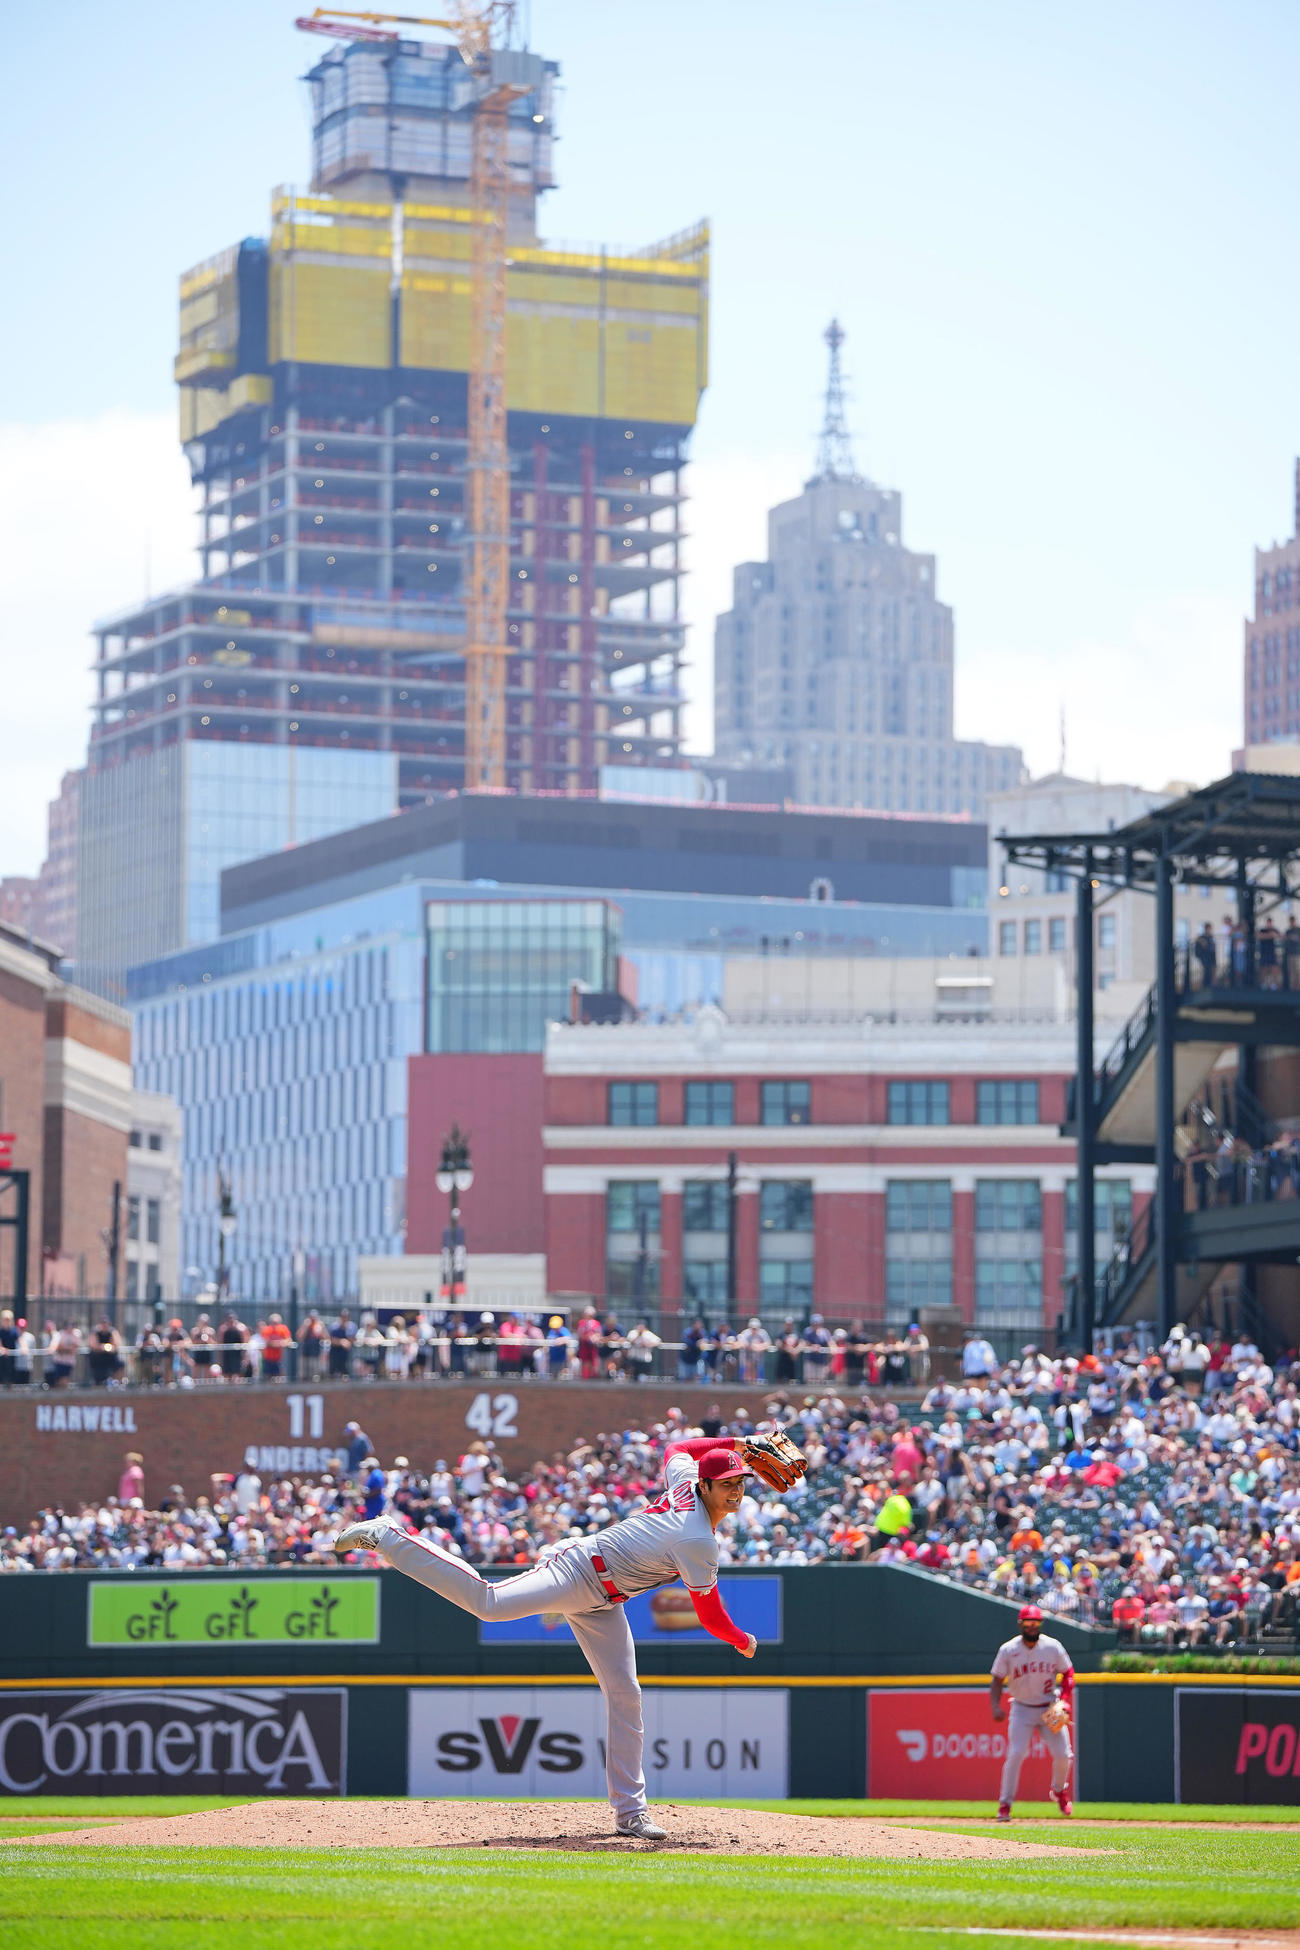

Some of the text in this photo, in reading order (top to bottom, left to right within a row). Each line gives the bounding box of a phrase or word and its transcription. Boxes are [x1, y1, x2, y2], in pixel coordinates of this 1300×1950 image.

[36, 1405, 137, 1432] HARWELL
[286, 1394, 324, 1438] 11
[465, 1393, 518, 1437] 42
[244, 1445, 350, 1473] ANDERSO
[126, 1593, 338, 1640] GFL GFL GFL
[1013, 1661, 1057, 1680] ANGELS
[1043, 1678, 1054, 1695] 2
[597, 1738, 760, 1770] SION
[932, 1733, 1046, 1759] DOORDH
[1235, 1722, 1300, 1777] PO
